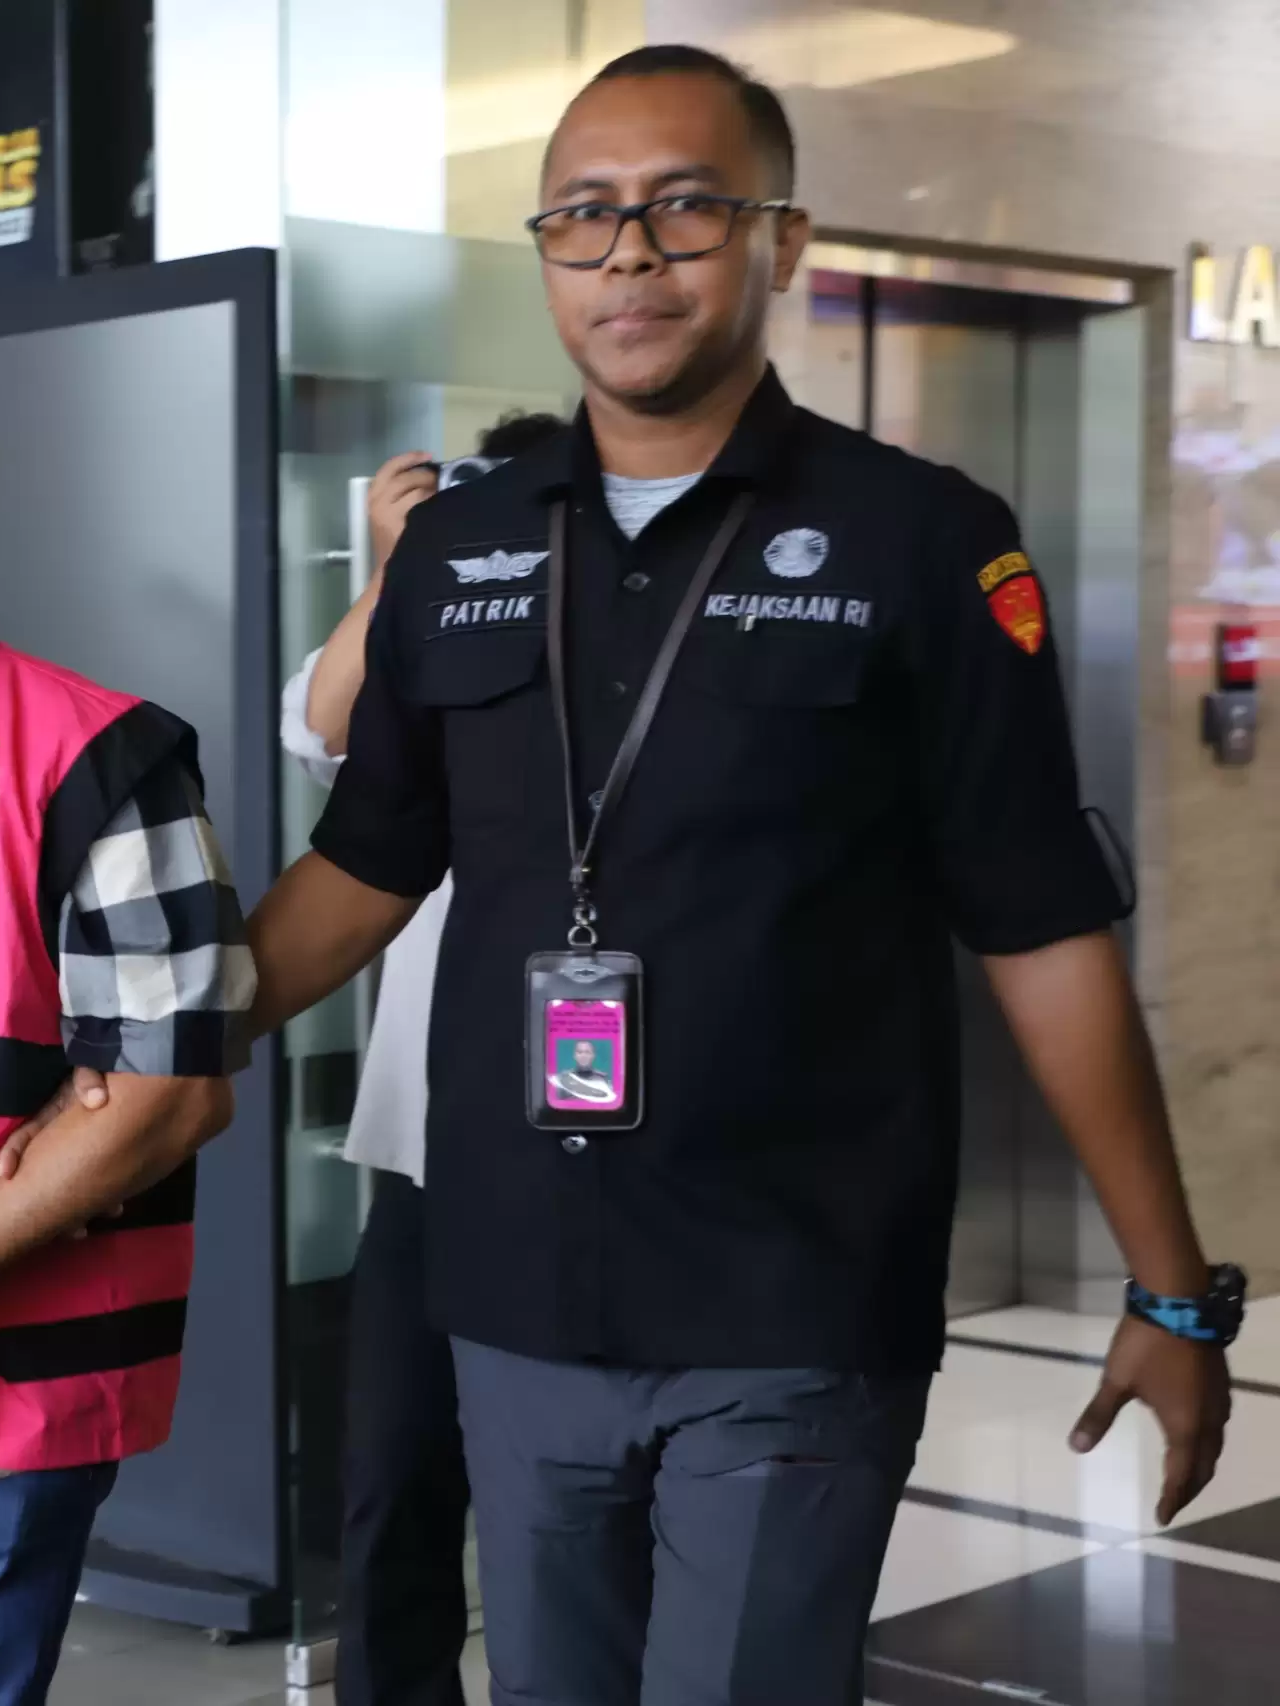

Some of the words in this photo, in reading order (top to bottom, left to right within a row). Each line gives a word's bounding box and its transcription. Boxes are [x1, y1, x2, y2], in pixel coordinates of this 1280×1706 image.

[439, 595, 536, 629] PATRIK
[703, 593, 841, 623] KEJAKSAAN
[843, 598, 874, 628] RI
